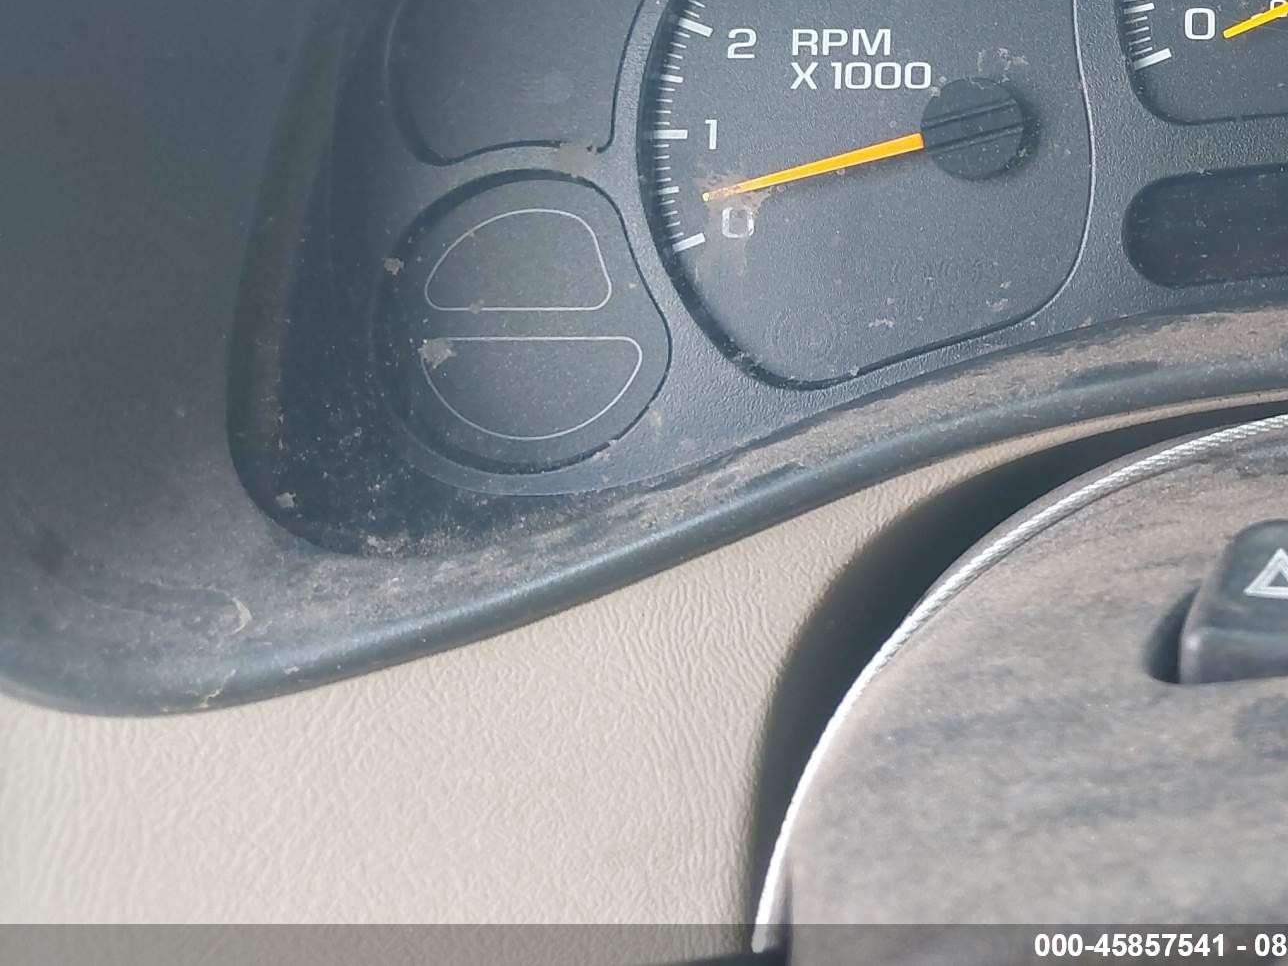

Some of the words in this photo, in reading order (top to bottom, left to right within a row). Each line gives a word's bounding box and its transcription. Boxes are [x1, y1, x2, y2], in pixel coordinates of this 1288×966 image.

[1184, 8, 1216, 40] 0
[727, 28, 757, 59] 2
[791, 28, 891, 56] RPM
[790, 62, 819, 90] X
[830, 61, 932, 90] 1000
[704, 119, 717, 150] 1
[721, 207, 754, 238] 0
